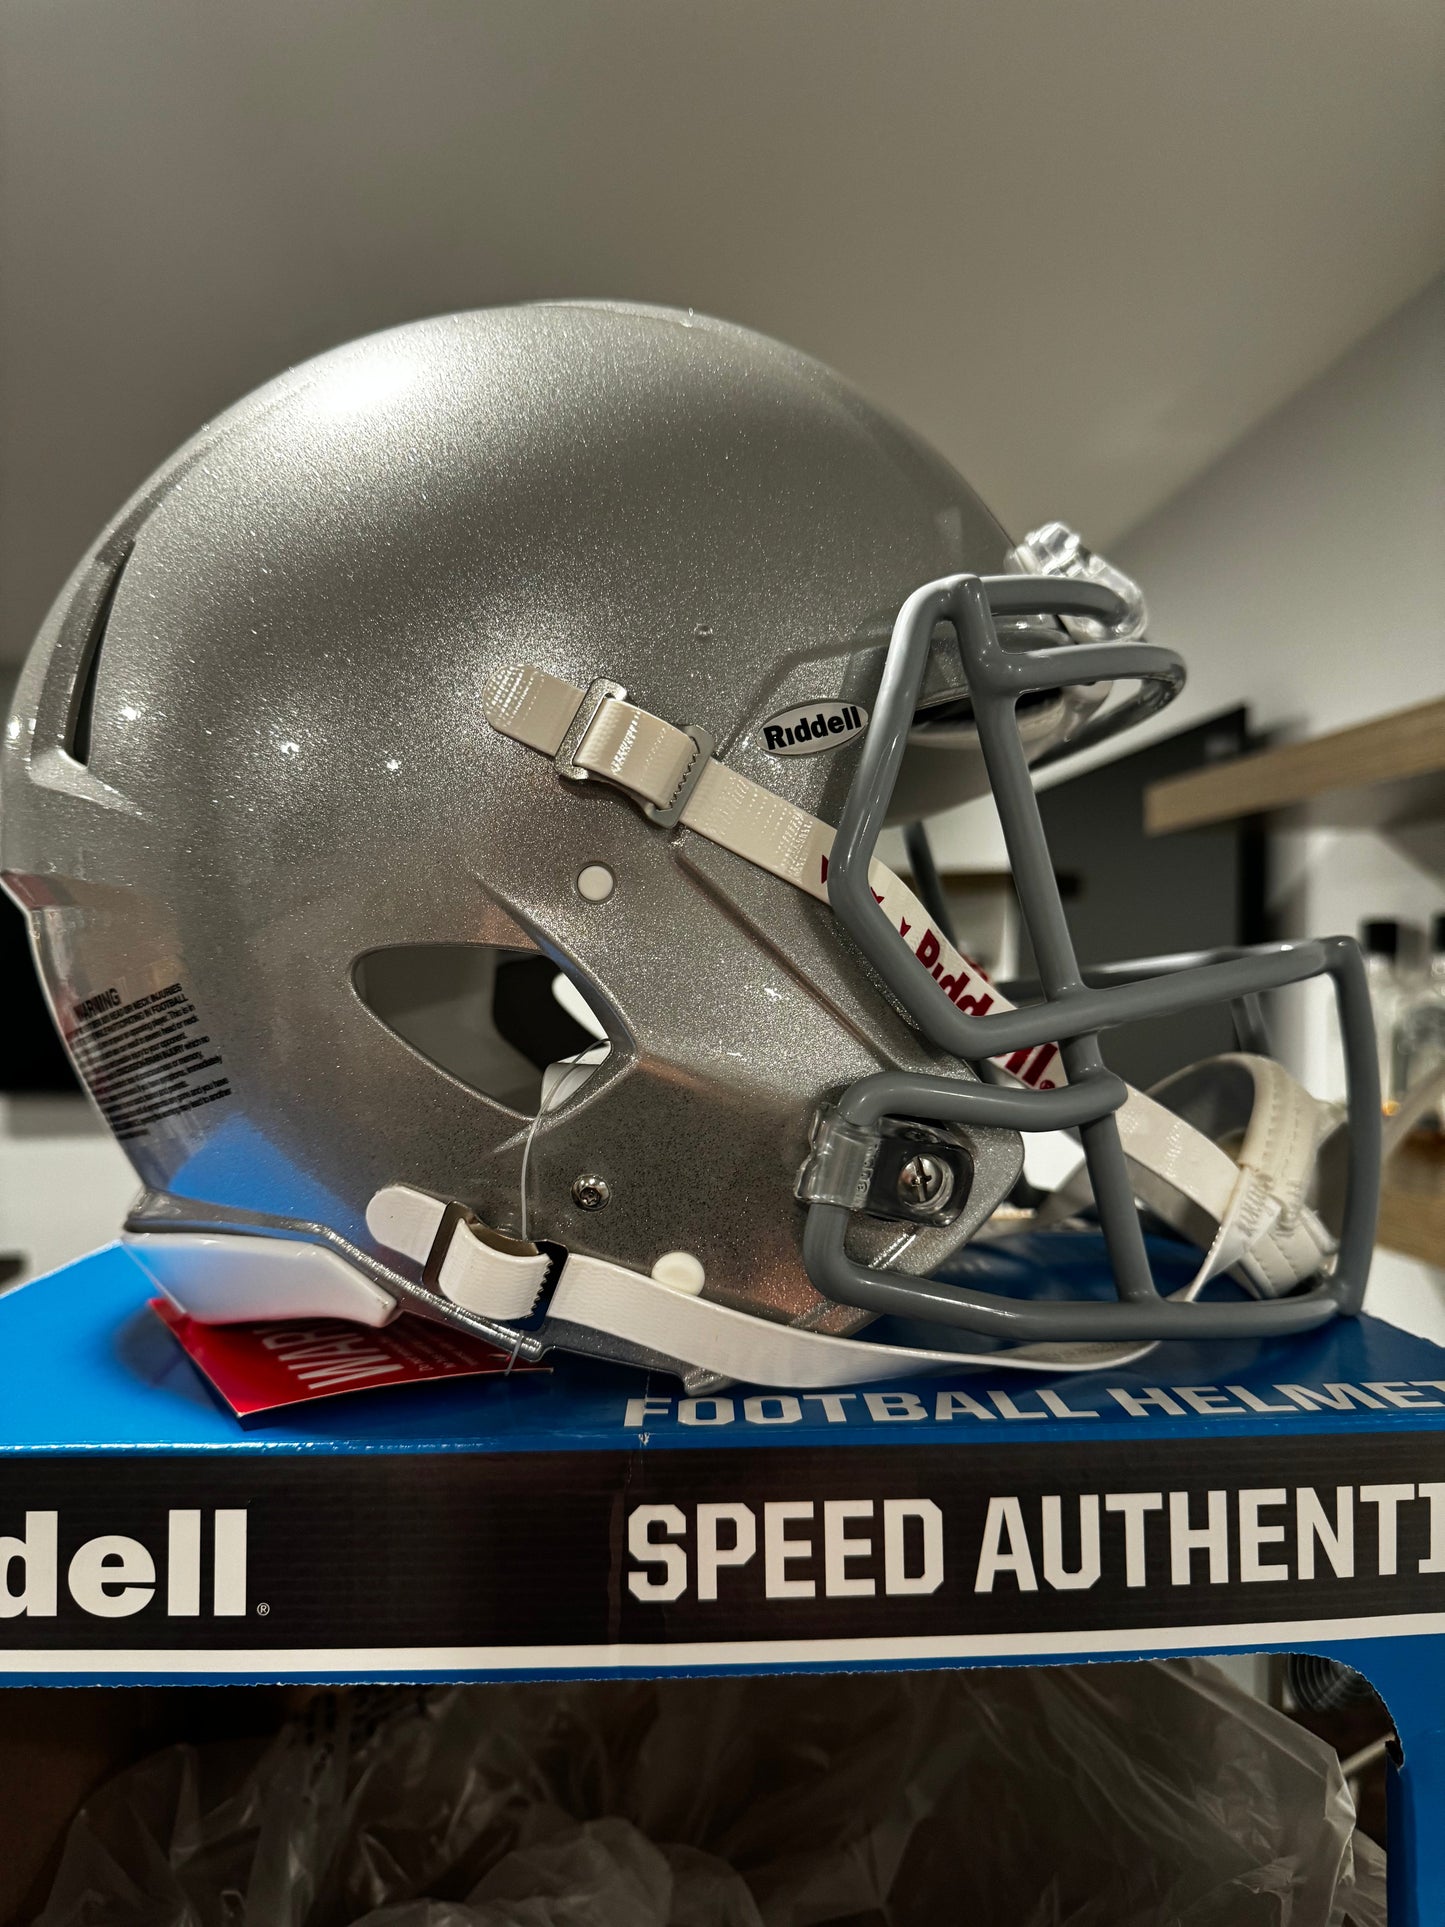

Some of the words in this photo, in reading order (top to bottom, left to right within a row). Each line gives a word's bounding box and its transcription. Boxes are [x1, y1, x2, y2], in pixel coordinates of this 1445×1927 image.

[763, 706, 861, 750] Riddell
[73, 988, 122, 1020] WARNING
[624, 1389, 1100, 1427] FOOTBALL
[628, 1497, 945, 1601] SPEED
